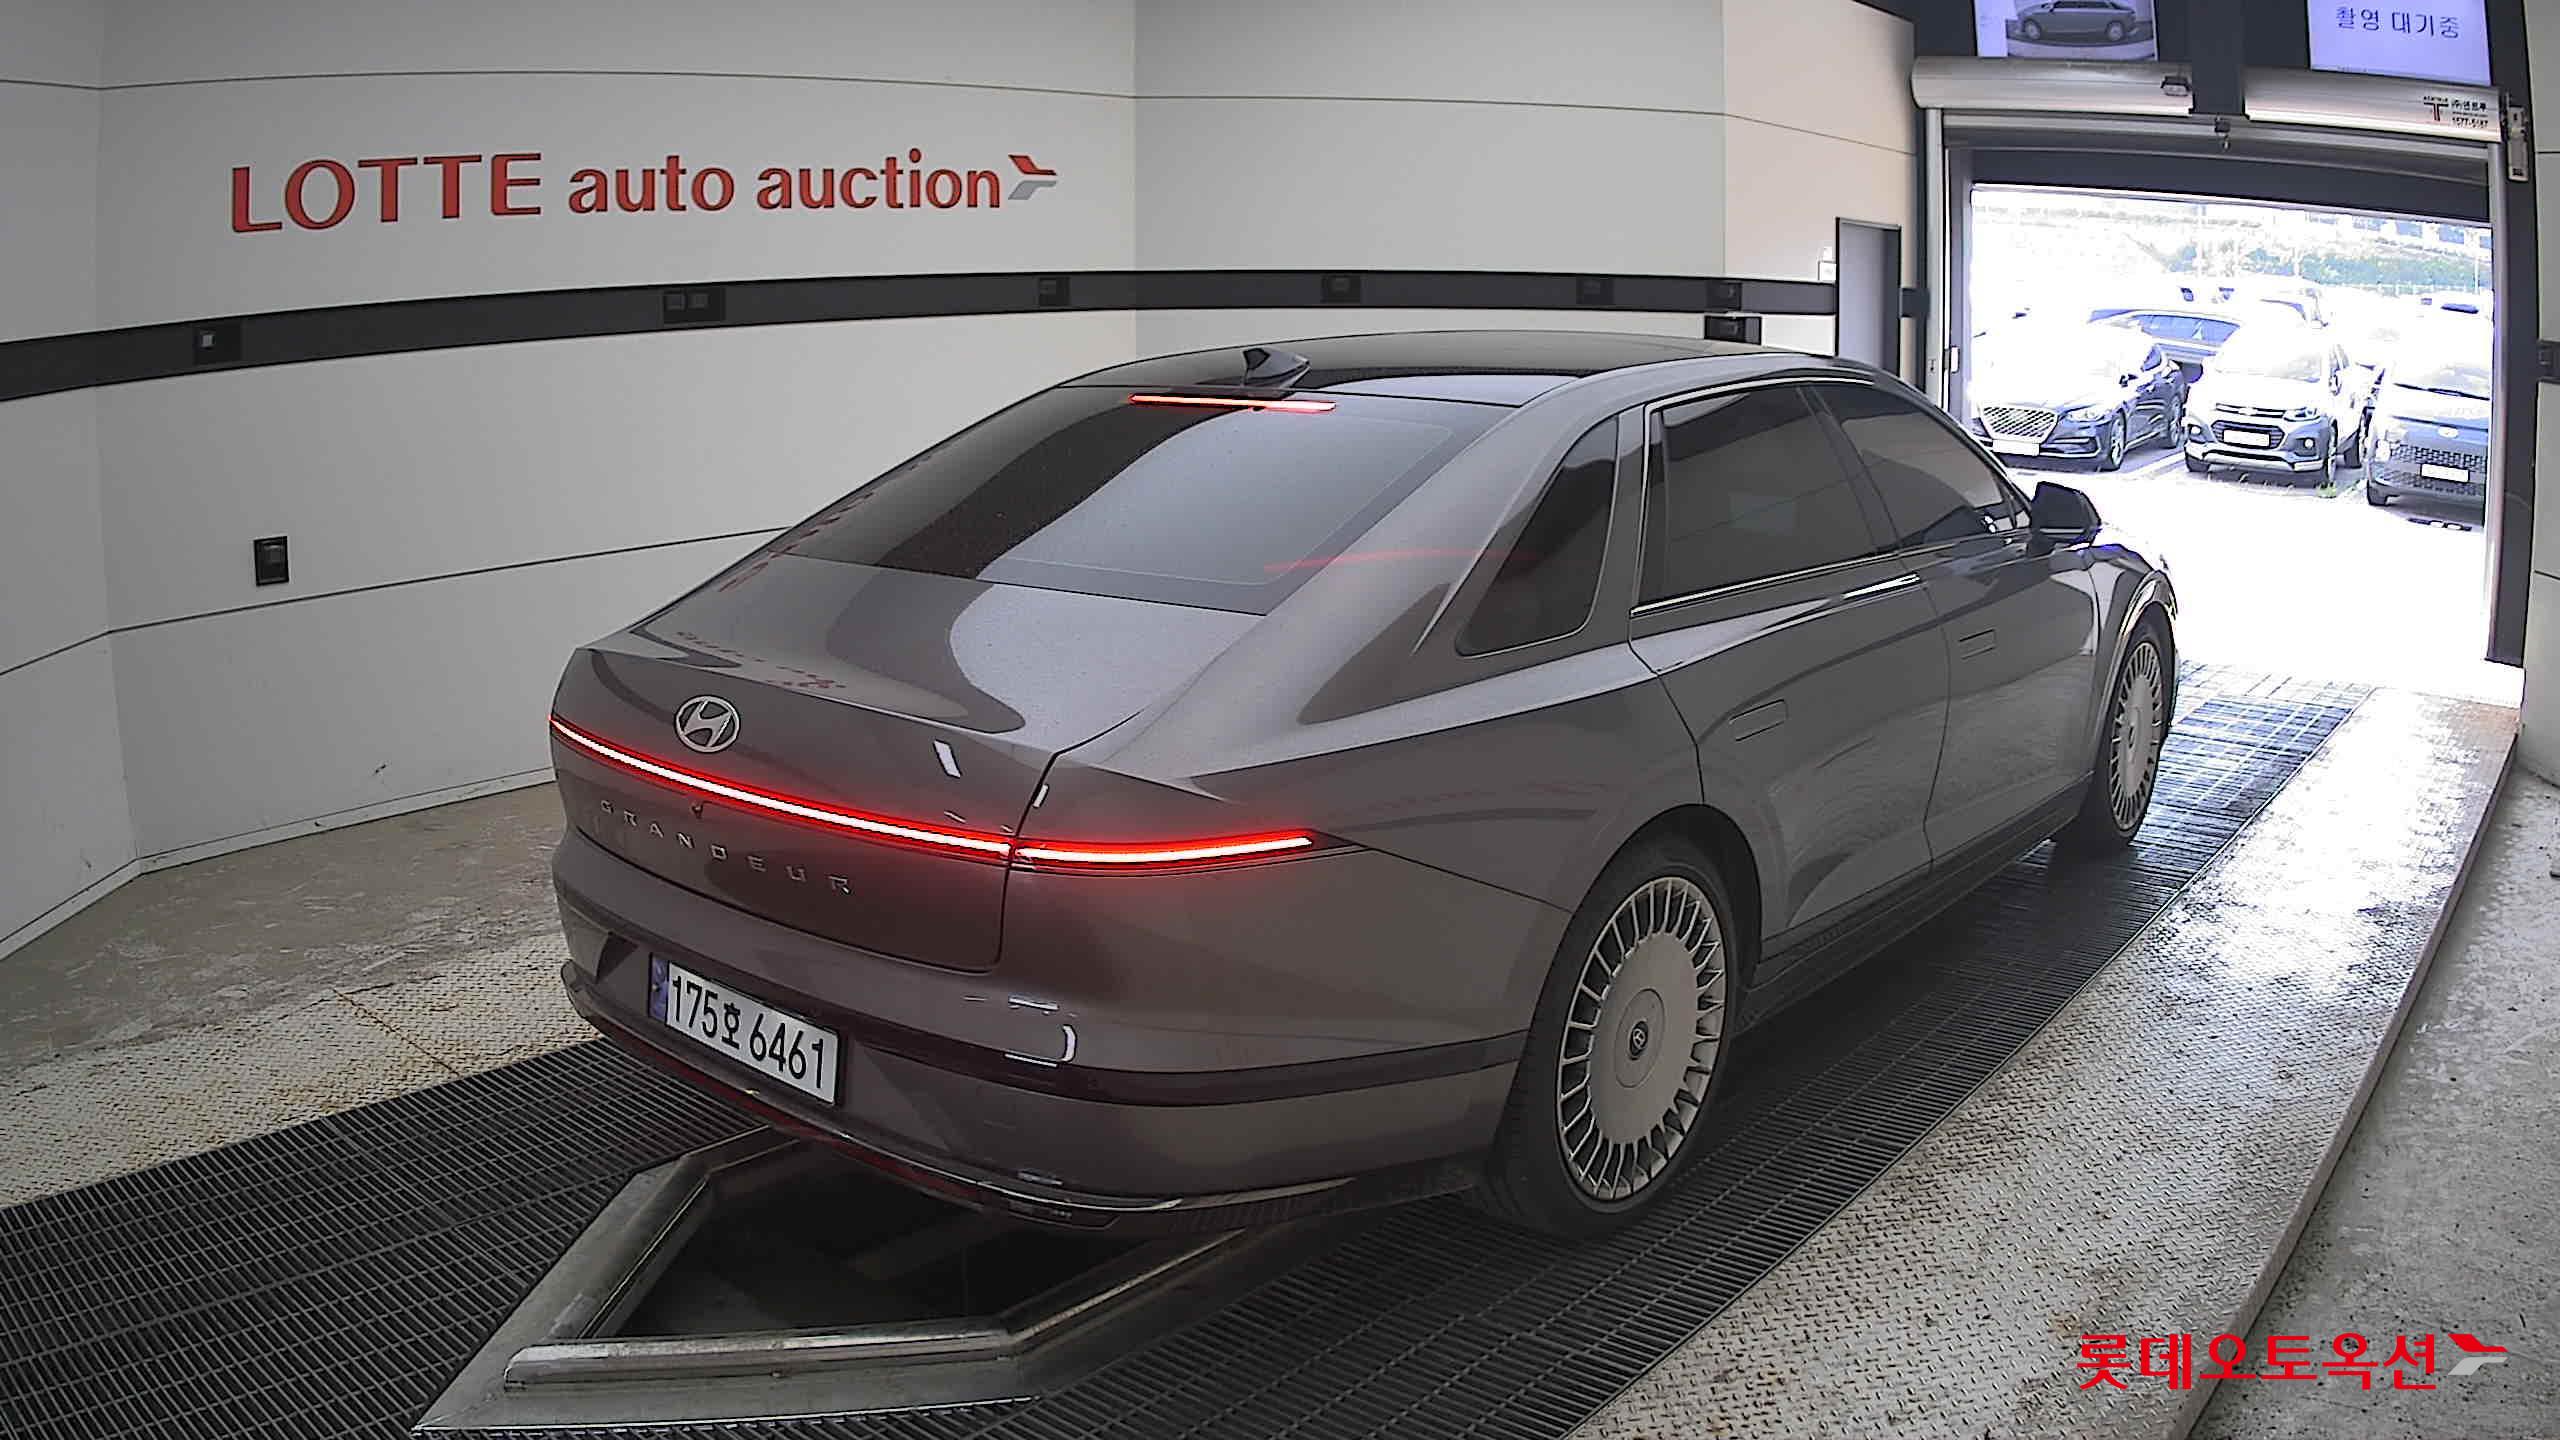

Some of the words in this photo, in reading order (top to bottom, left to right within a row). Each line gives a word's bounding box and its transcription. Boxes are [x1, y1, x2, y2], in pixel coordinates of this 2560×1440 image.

[2336, 6, 2379, 31] 촬영
[2391, 12, 2459, 39] 대기중
[231, 152, 543, 233] LOTTE
[568, 153, 735, 214] auto
[756, 147, 1002, 210] auction
[600, 799, 853, 895] GRANDEUR
[671, 974, 743, 1051] 175호
[749, 1012, 825, 1090] 6461
